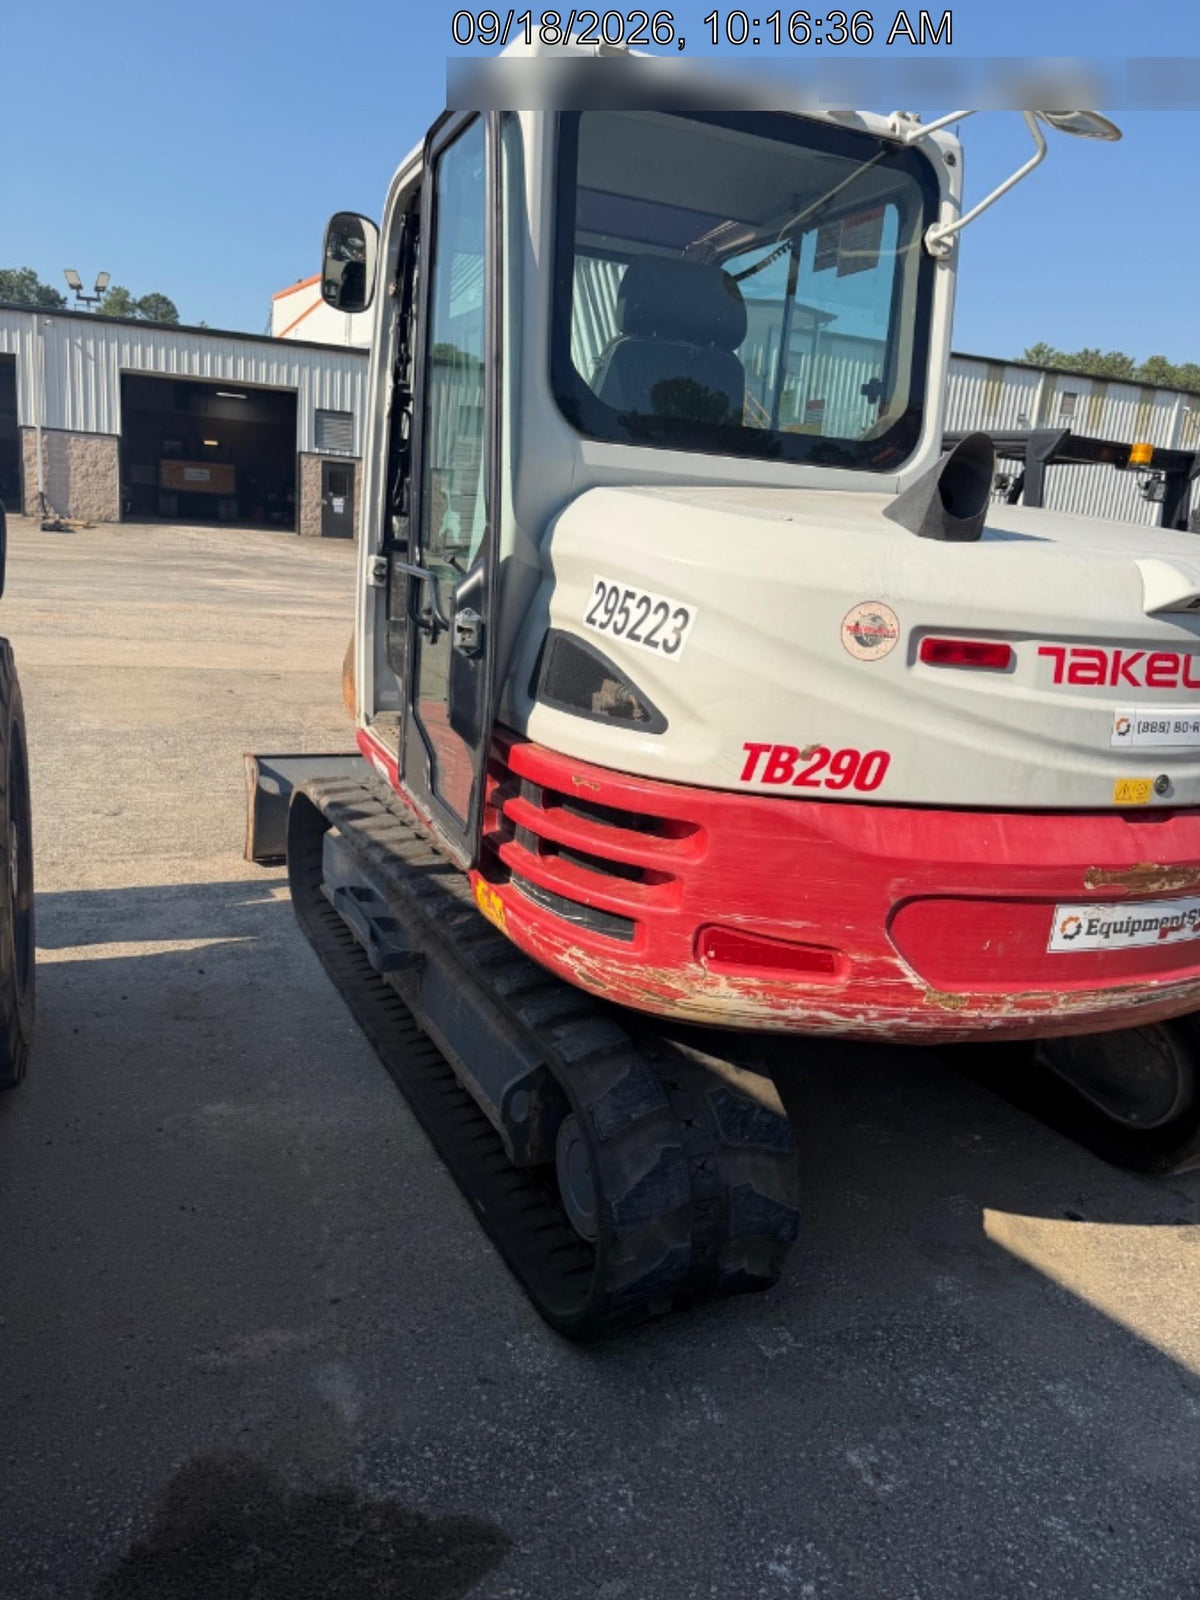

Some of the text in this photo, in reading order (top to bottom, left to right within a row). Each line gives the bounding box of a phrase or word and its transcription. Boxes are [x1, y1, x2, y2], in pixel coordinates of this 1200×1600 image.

[586, 581, 690, 654] 295223
[740, 742, 891, 791] TB290
[1084, 907, 1200, 939] EquipmentS
